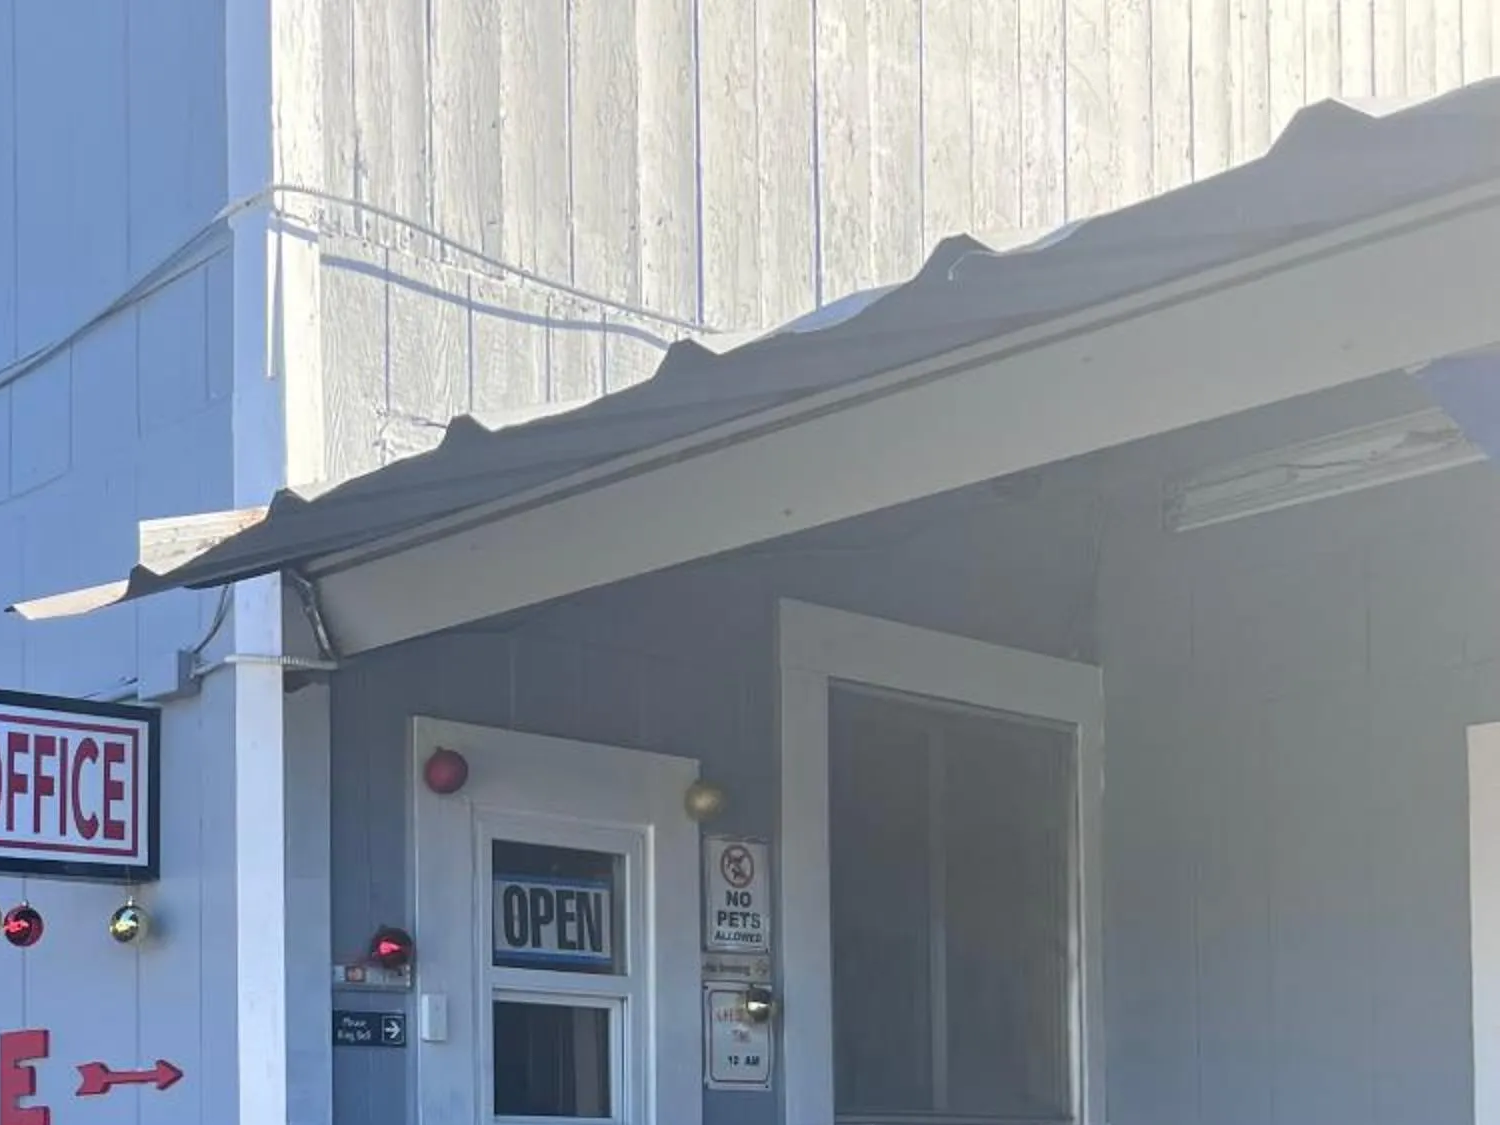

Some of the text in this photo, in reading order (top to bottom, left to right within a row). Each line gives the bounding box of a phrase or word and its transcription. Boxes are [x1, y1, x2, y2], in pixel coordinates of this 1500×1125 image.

[725, 890, 753, 908] NO
[503, 884, 602, 953] OPEN
[717, 911, 761, 929] PETS
[714, 930, 763, 943] ALLOWED
[744, 1055, 760, 1066] AM
